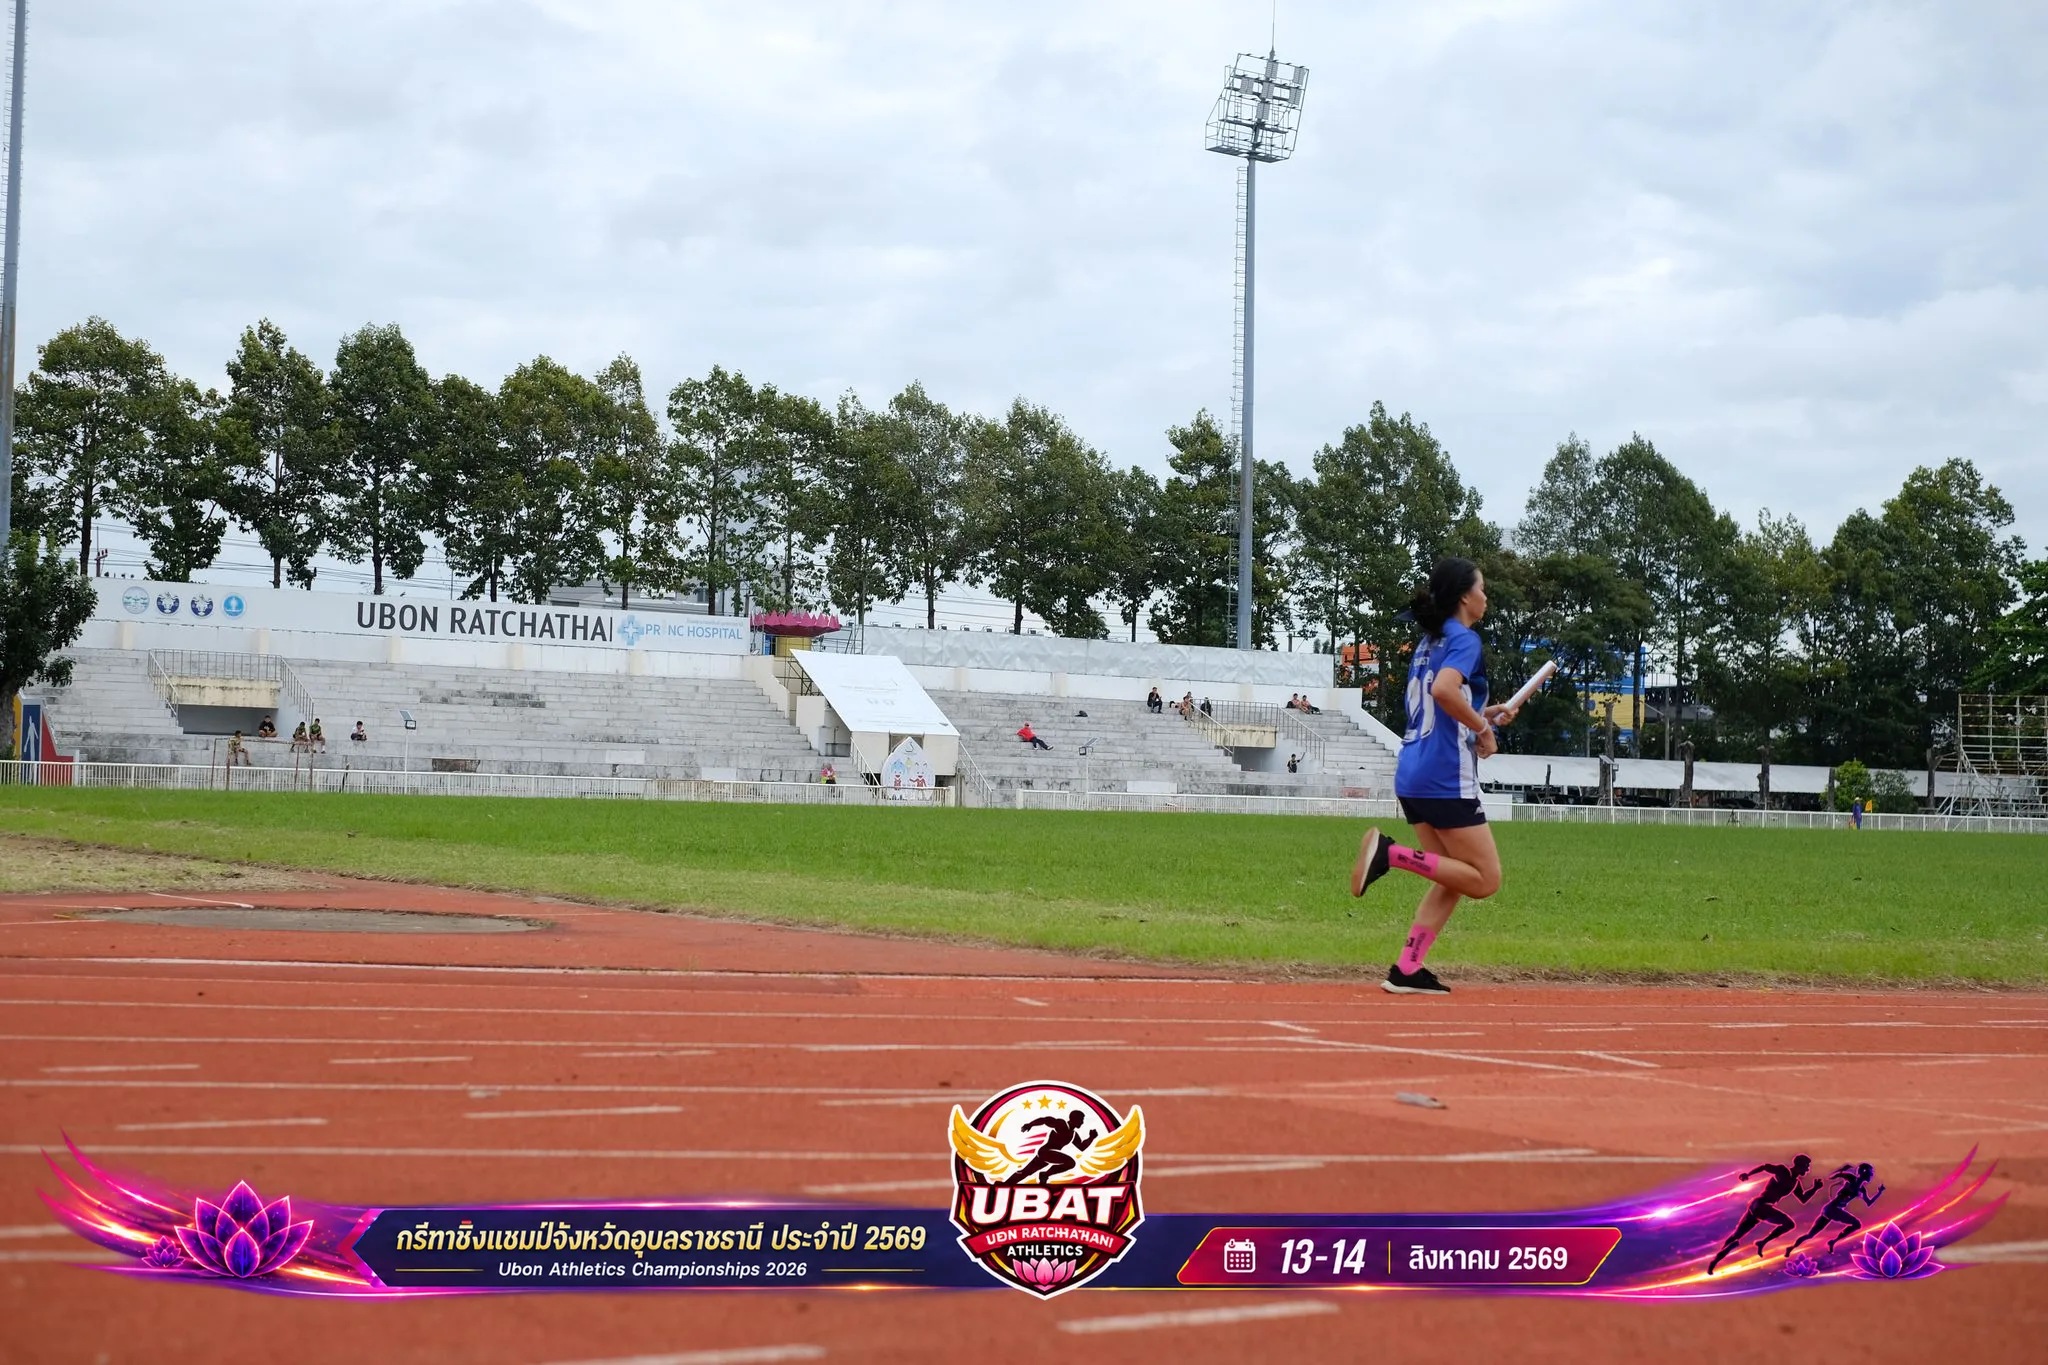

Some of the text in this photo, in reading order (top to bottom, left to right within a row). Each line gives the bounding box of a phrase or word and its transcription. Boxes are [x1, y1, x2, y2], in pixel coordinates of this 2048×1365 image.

[357, 601, 614, 643] UBON RATCHATHA
[687, 626, 743, 640] HOSPITAL
